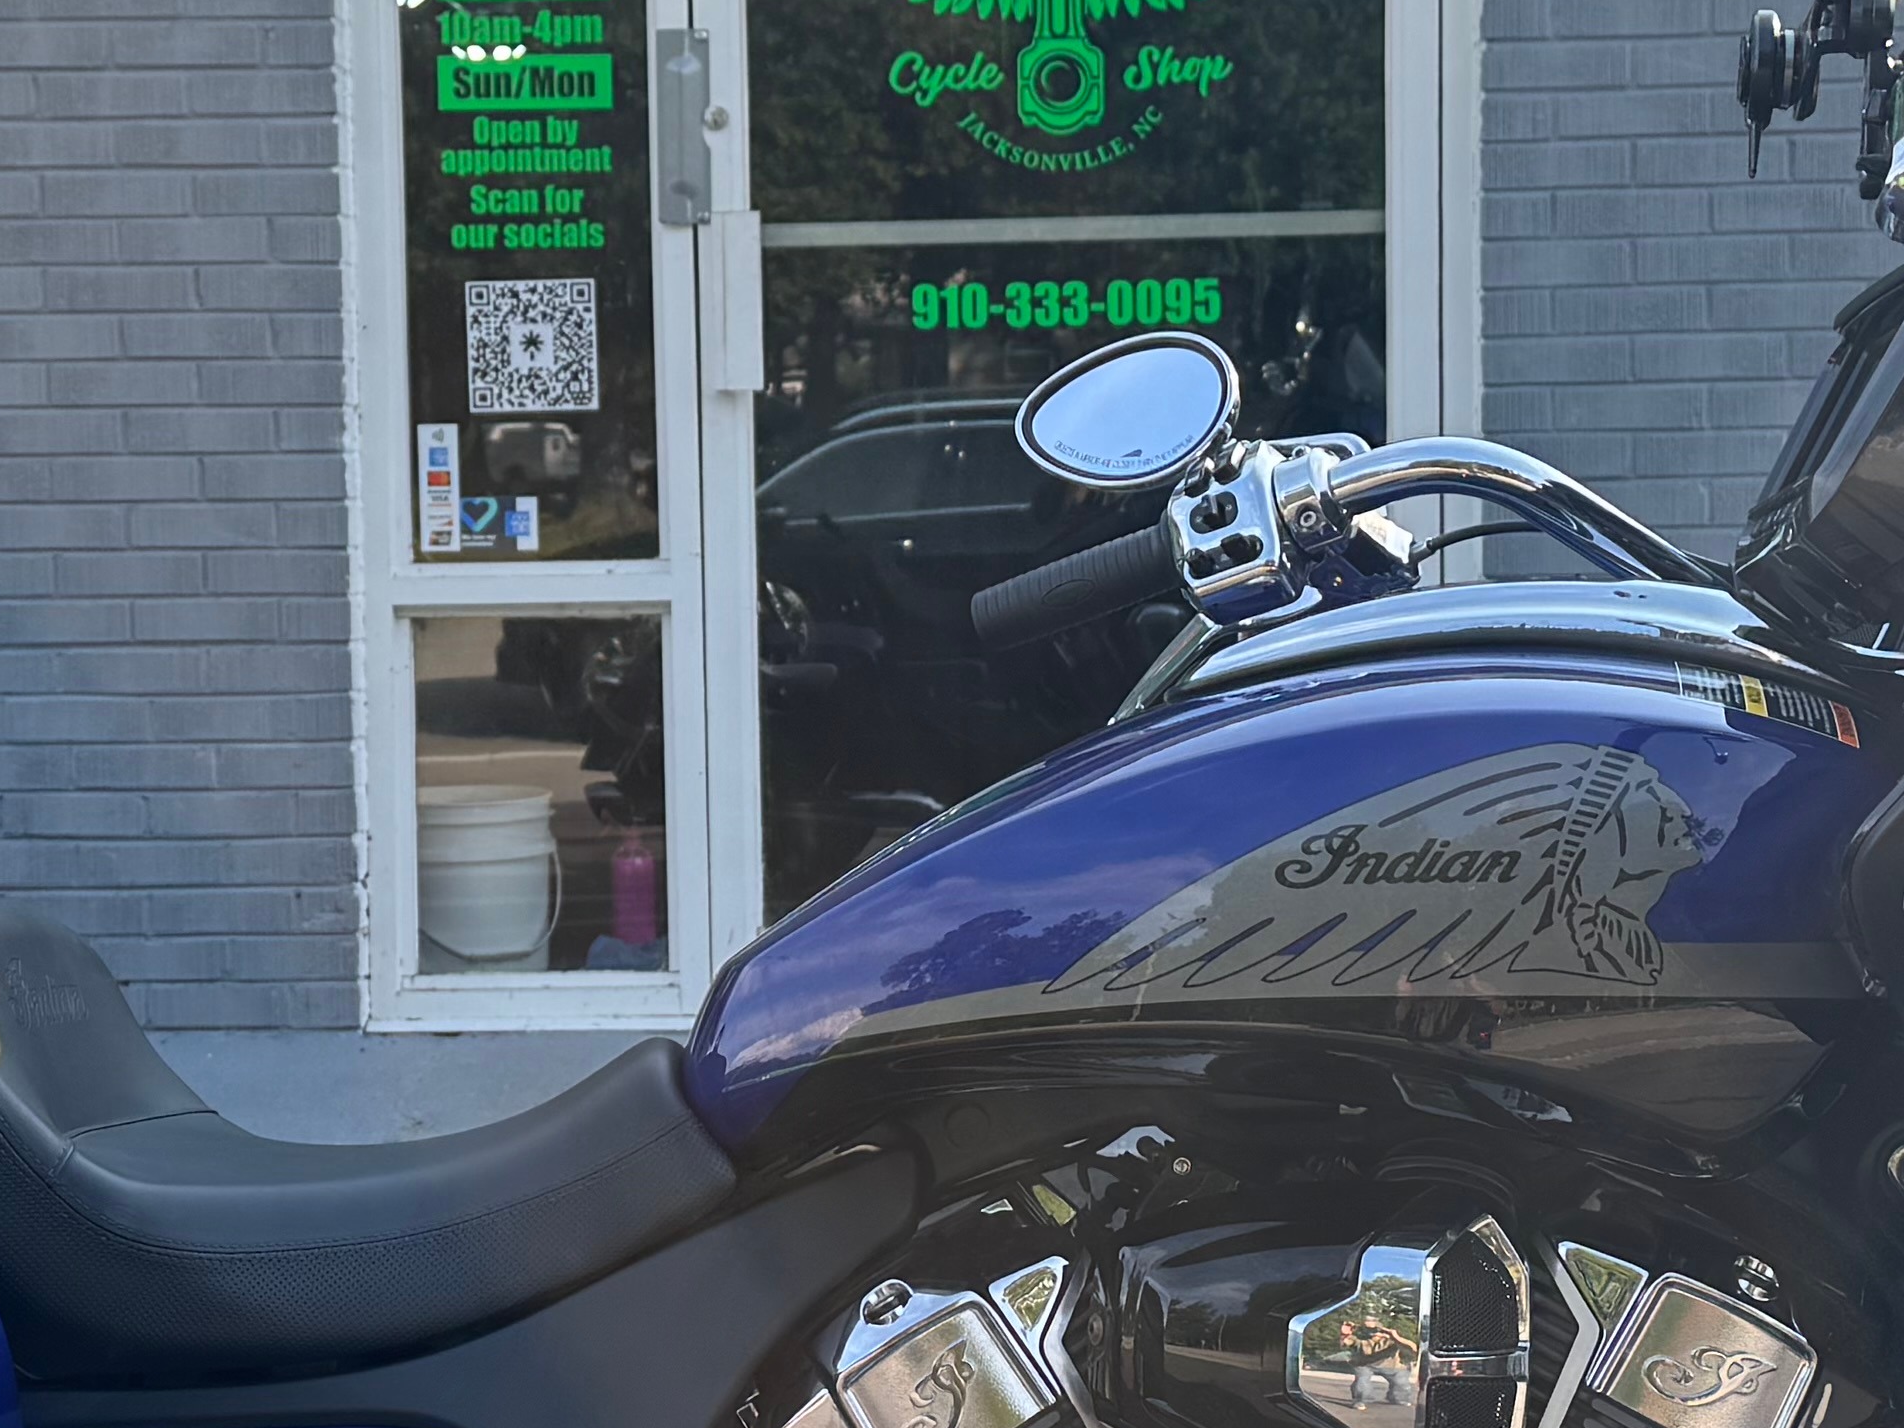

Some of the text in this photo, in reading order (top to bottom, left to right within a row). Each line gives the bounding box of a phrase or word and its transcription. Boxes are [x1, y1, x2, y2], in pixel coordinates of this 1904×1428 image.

[436, 10, 603, 47] 10am-4pm
[453, 65, 596, 99] Sun/Mon
[889, 46, 1234, 107] Cycle Shop
[472, 115, 579, 148] Open by
[956, 104, 1164, 172] JACKSONVILLE, NC
[441, 144, 612, 177] appointment
[470, 184, 584, 216] Scan for
[451, 218, 605, 249] our socials
[911, 277, 1222, 330] 910-333-0095
[1275, 824, 1523, 888] Indian
